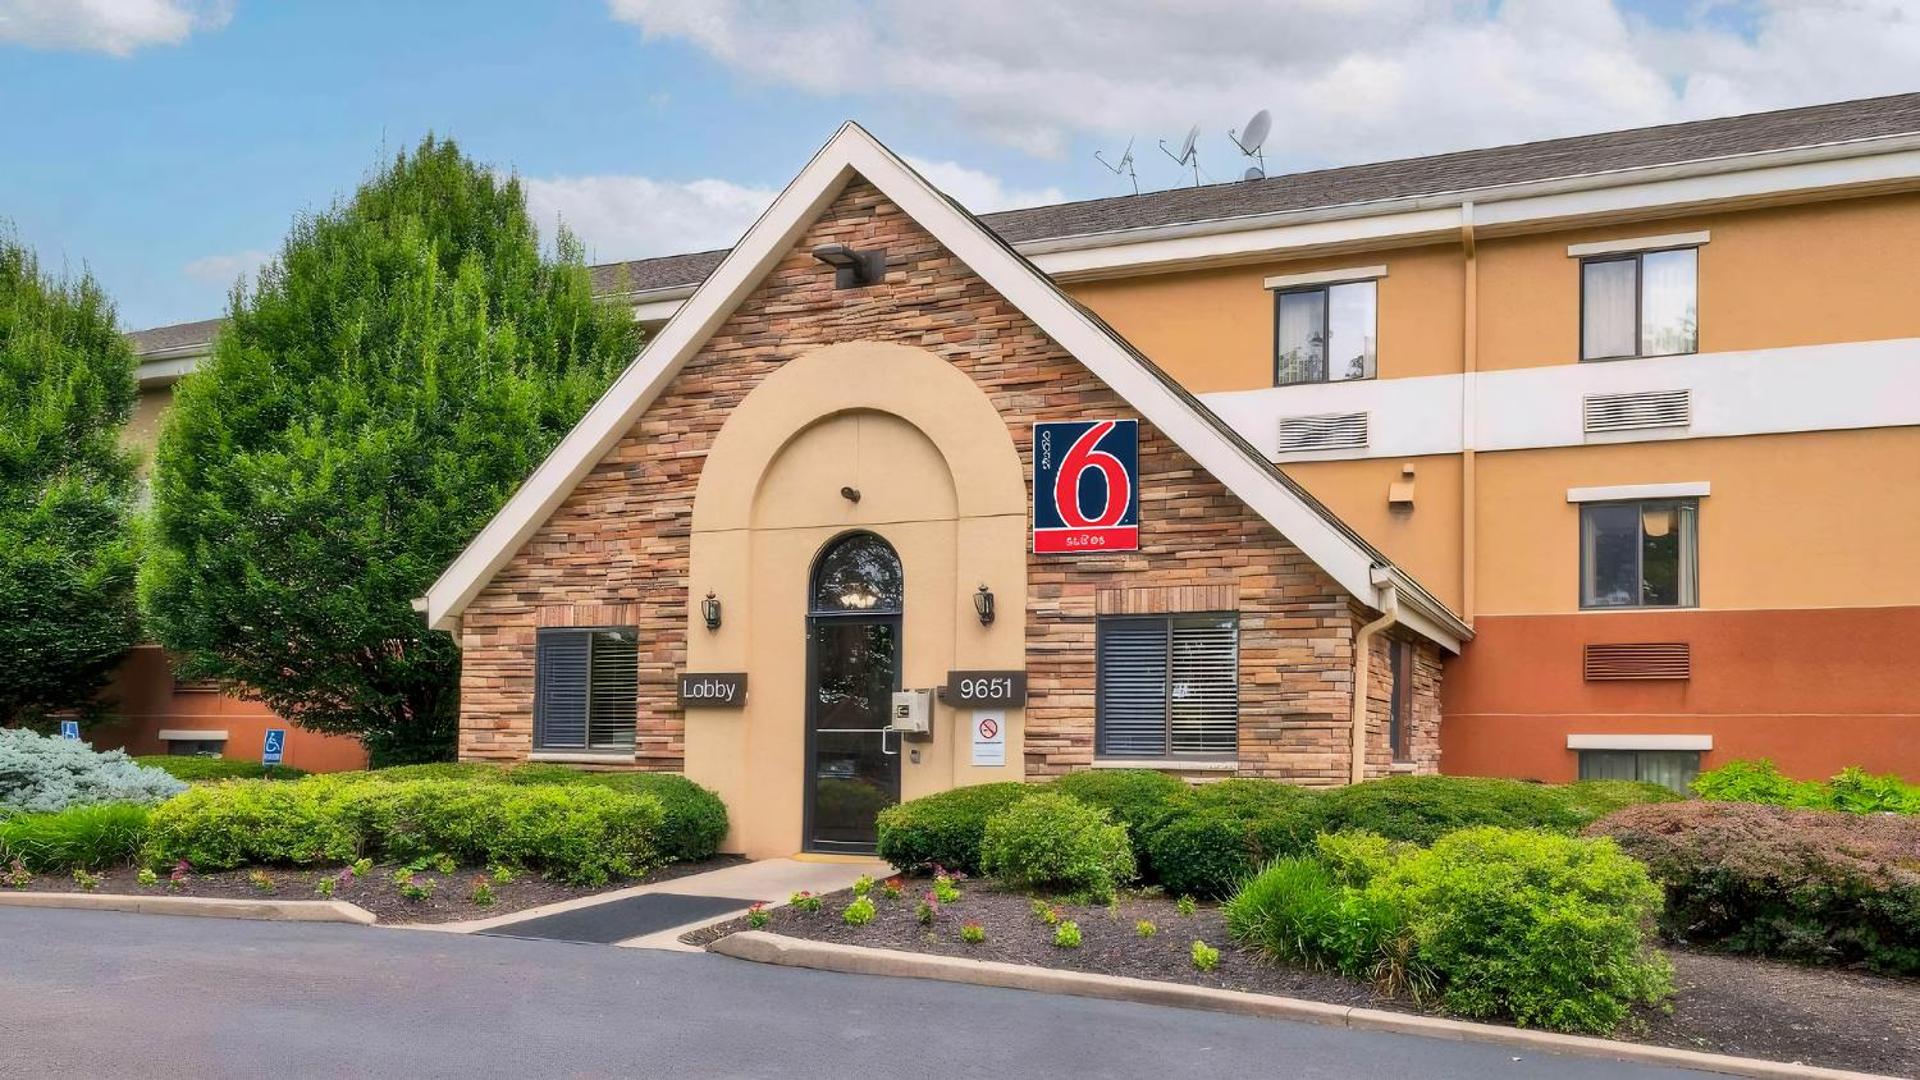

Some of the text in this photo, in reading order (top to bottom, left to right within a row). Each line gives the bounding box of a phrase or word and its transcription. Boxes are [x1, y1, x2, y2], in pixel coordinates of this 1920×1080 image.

[1054, 421, 1131, 528] 6
[683, 678, 736, 702] Lobby
[960, 678, 1012, 699] 9651
